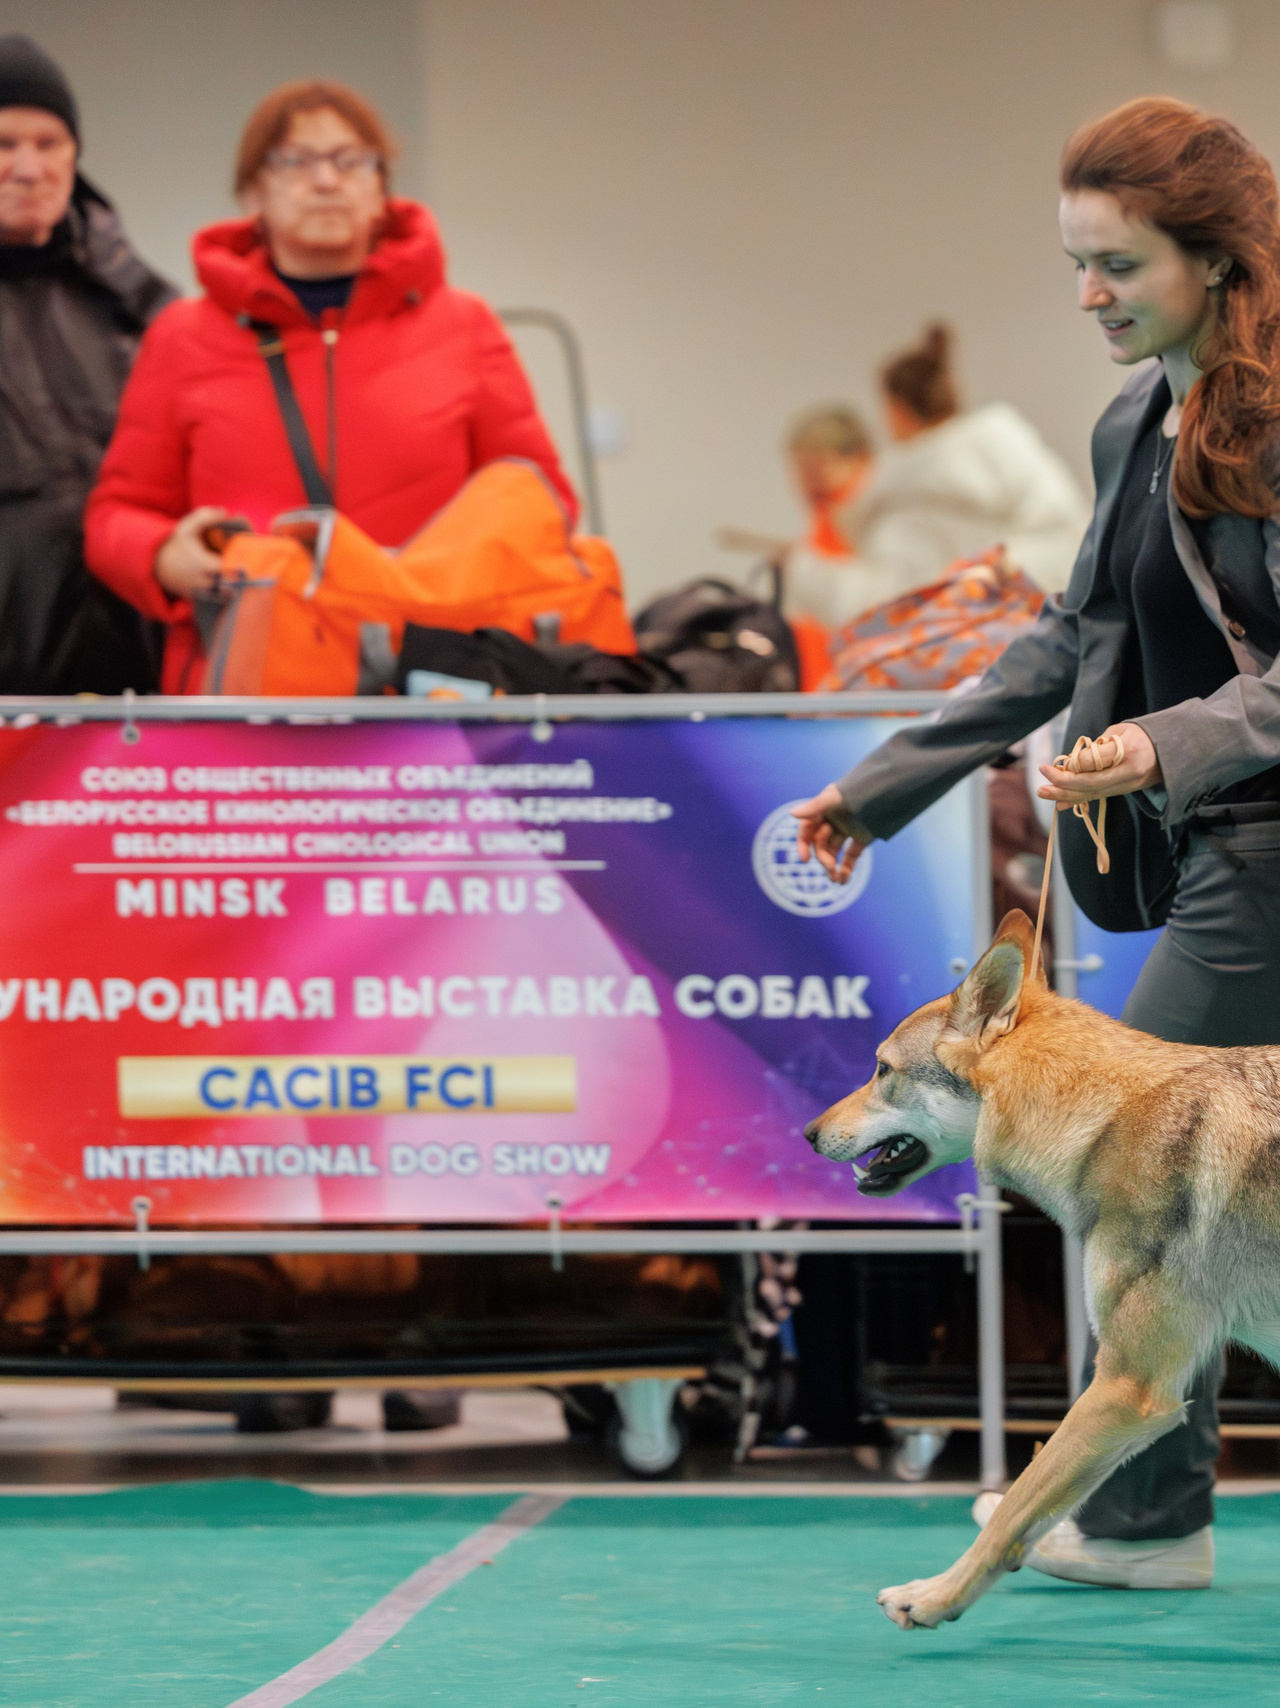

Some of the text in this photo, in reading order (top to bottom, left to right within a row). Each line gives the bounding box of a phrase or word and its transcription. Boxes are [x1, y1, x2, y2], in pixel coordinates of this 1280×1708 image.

[81, 760, 593, 793] СОЮЗ ОБЩЕСТВЕННЫХ ОБЪЕДИНЕНИЙ
[215, 799, 459, 823] КИНОЛОГИЧЕСКОЕ
[113, 831, 565, 857] BELORUSSIAN CINOLOGICAL UNION
[116, 877, 565, 917] MINSK BELARUS
[354, 975, 661, 1020] ВЫСТАВКА
[675, 975, 873, 1019] СОБАК
[199, 1064, 496, 1111] CACIB FCI
[83, 1143, 611, 1180] INTERNATIONAL DOG SHOW
